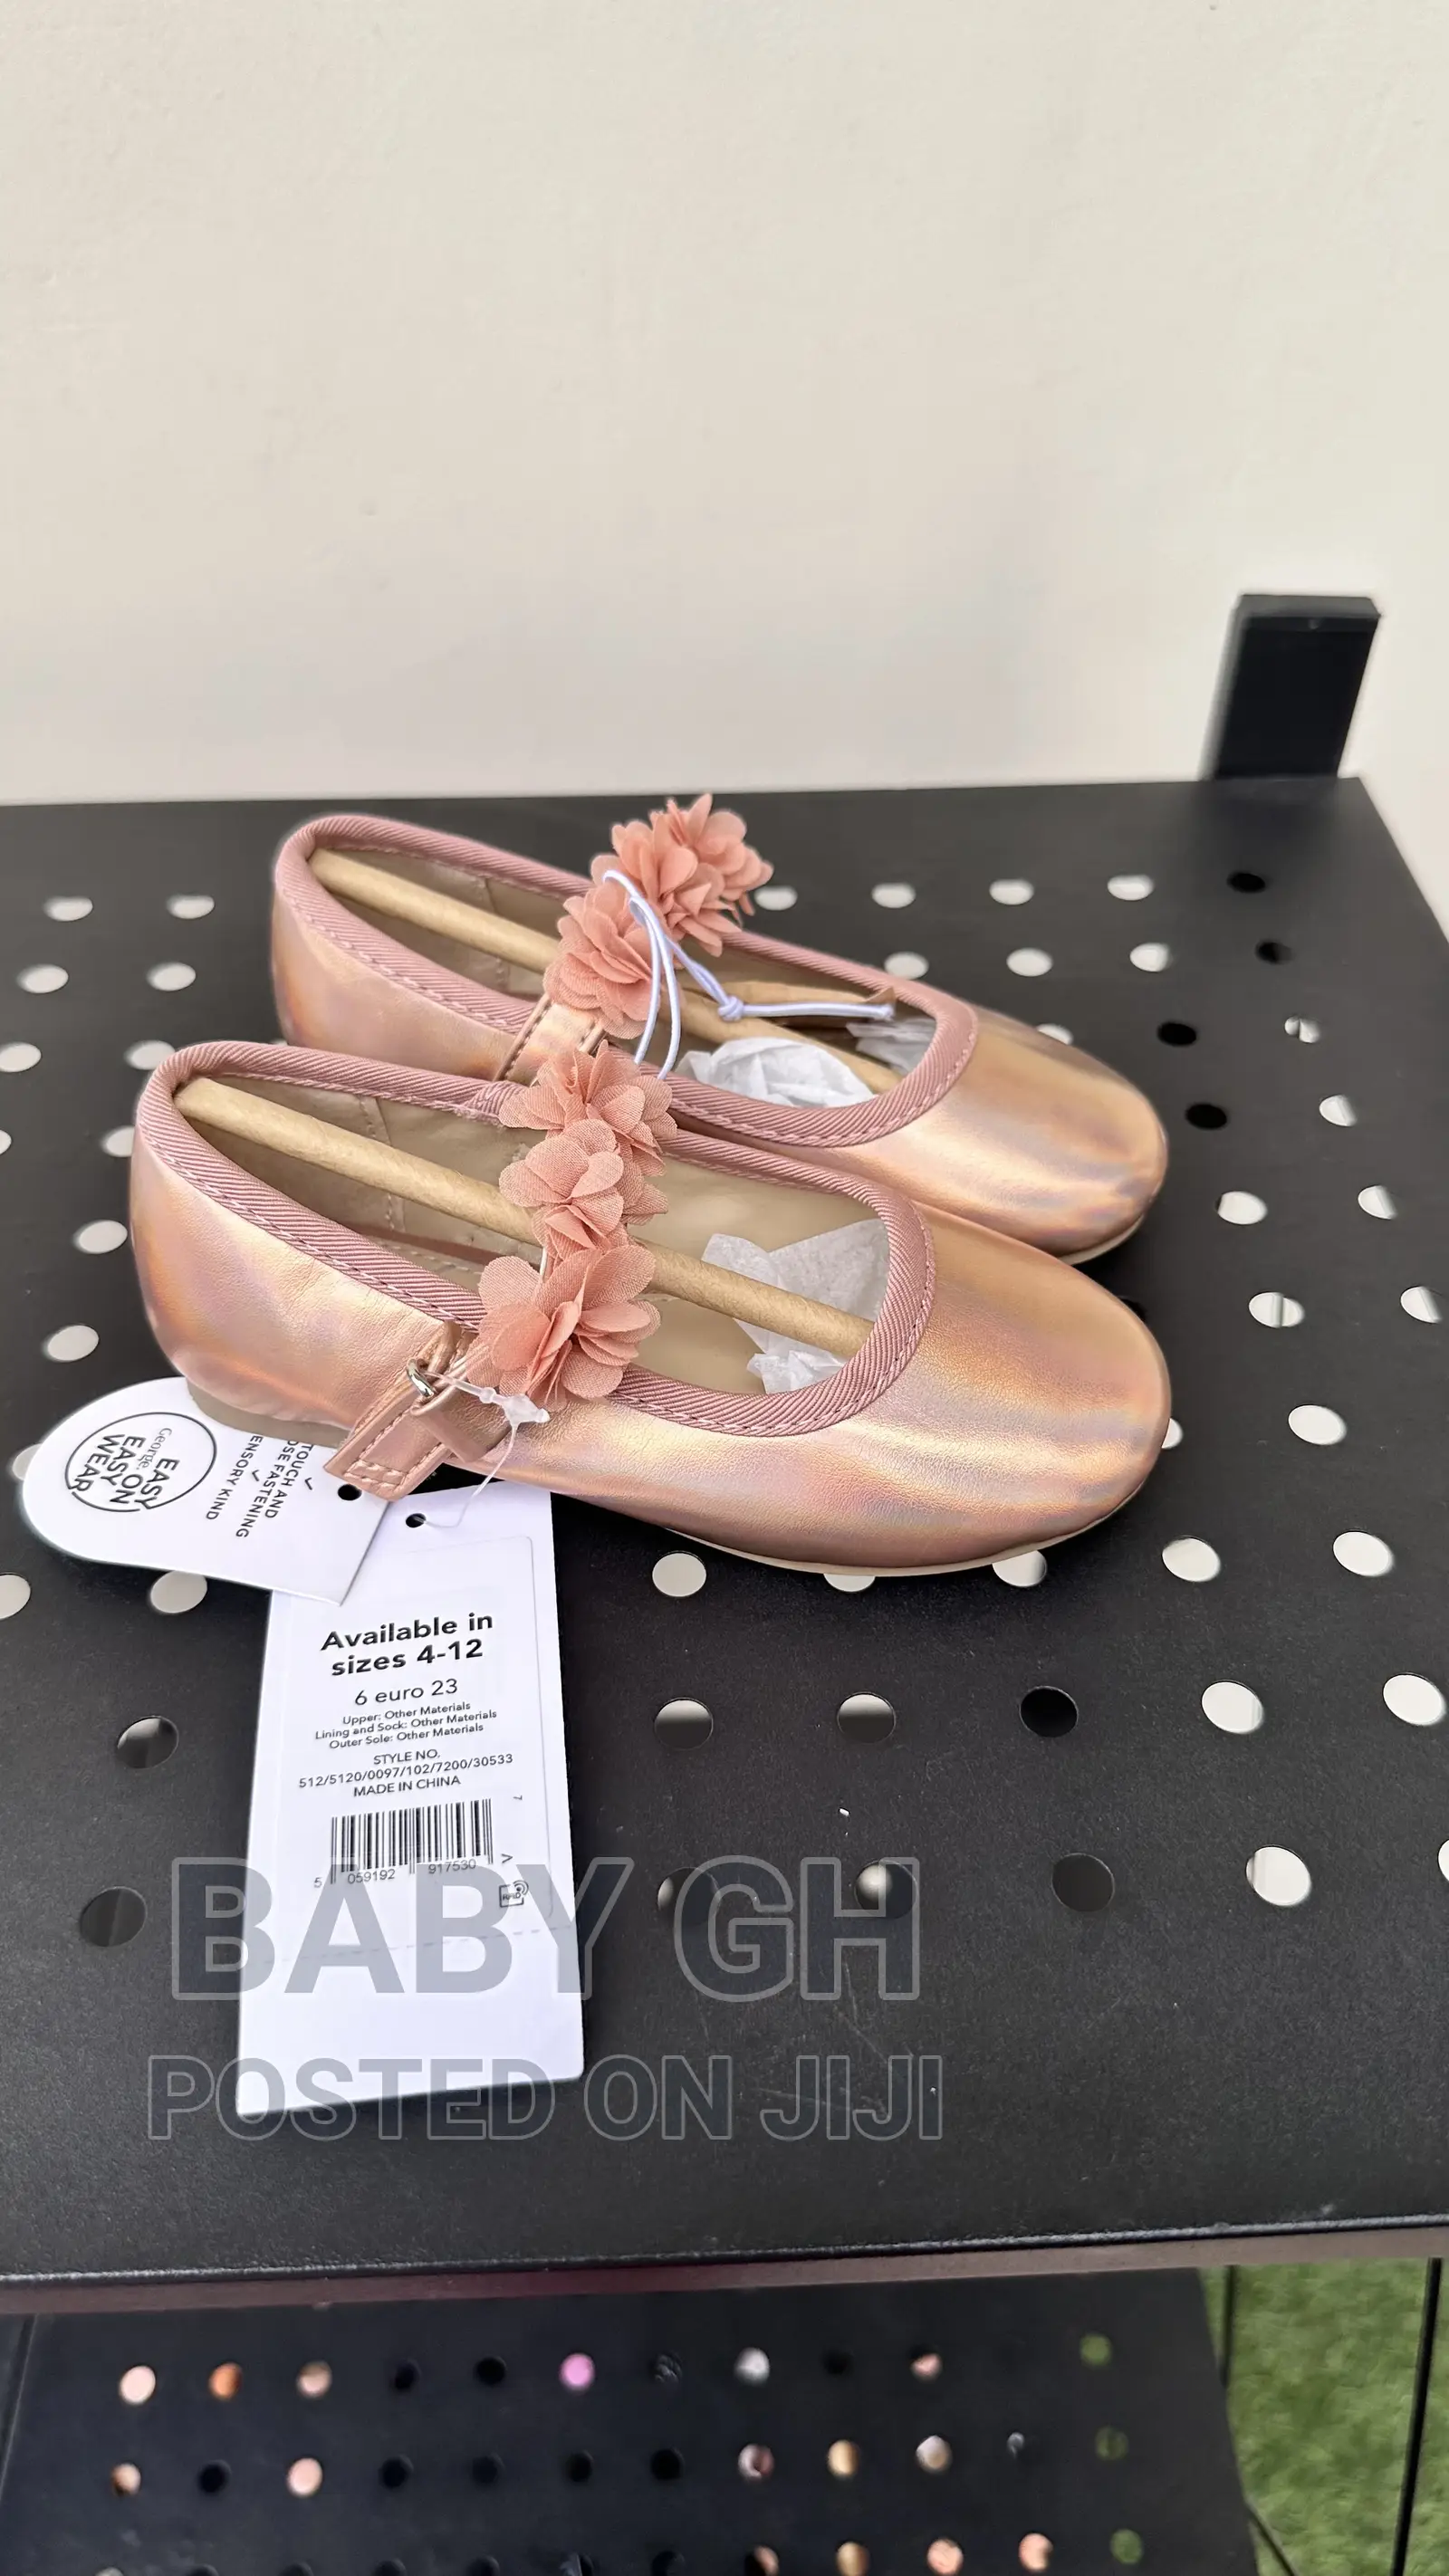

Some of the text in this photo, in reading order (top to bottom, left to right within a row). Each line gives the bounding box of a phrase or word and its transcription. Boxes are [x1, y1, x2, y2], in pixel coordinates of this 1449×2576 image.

[74, 1434, 125, 1492] WEAR
[101, 1436, 146, 1486] EASY
[206, 1435, 264, 1520] ENSORY KIND
[110, 1474, 143, 1504] ON
[134, 1458, 180, 1509] EASY
[264, 1443, 314, 1518] TOUCH AND
[235, 1464, 285, 1537] FASTENING
[321, 1612, 493, 1651] Available in
[331, 1638, 483, 1676] sizes 4-12
[354, 1678, 458, 1706] 6 euro 23
[315, 1709, 497, 1740] Lining and Sock: Other Materials
[342, 1701, 471, 1727] Upper: Other Materials
[329, 1723, 484, 1749] Outer Sole: Other Materials
[299, 1753, 513, 1788] 512/5120/0097/102/7200/30533
[373, 1748, 441, 1766] STYLE NO.
[353, 1775, 461, 1797] MADE IN CHINA
[313, 1858, 476, 1889] 5 059192 917530
